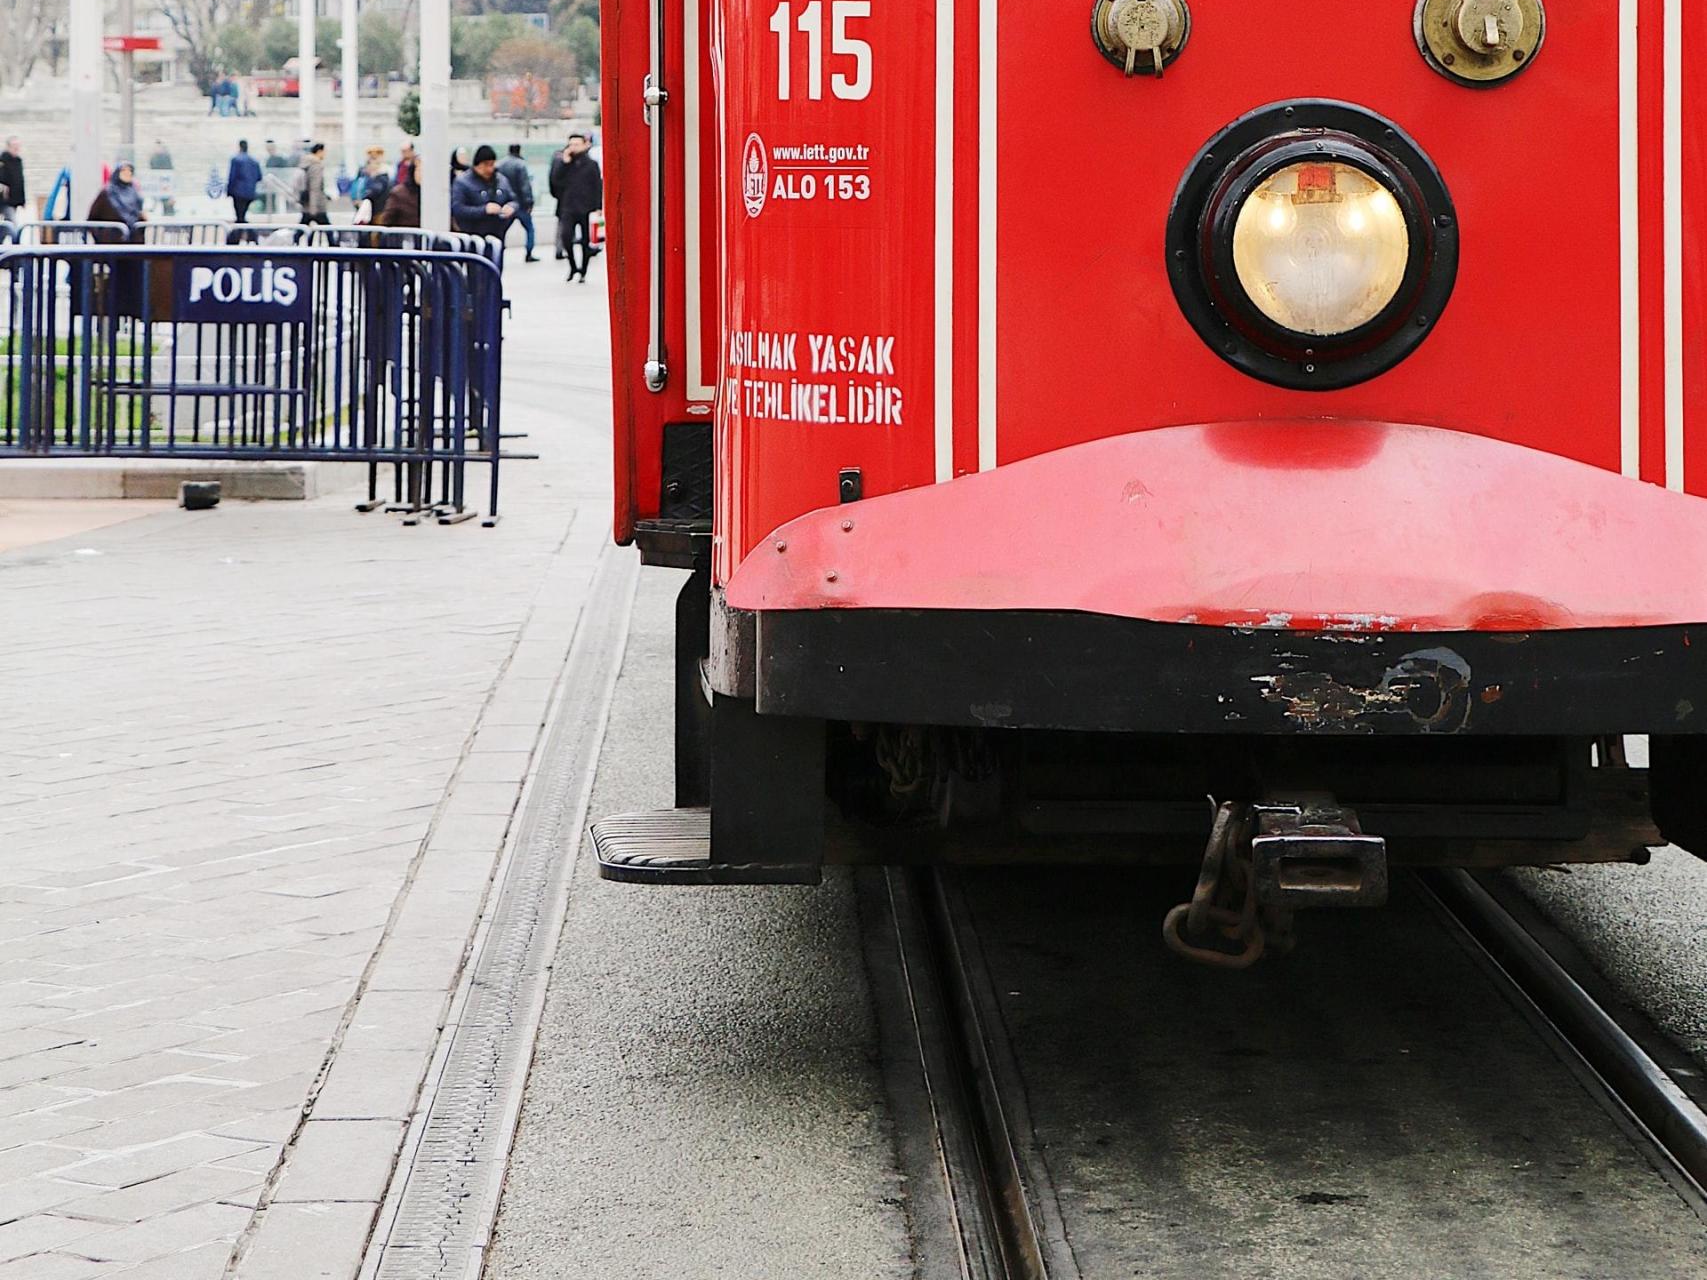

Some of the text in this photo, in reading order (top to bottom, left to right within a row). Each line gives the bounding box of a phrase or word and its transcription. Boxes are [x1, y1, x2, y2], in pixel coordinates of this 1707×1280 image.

[769, 0, 872, 100] 115
[772, 144, 870, 163] www.iett.gov.tr
[772, 174, 870, 199] ALO 153
[189, 259, 298, 306] POLİS
[808, 334, 895, 375] YASAK
[743, 378, 902, 425] TEHLİKELİDİR
